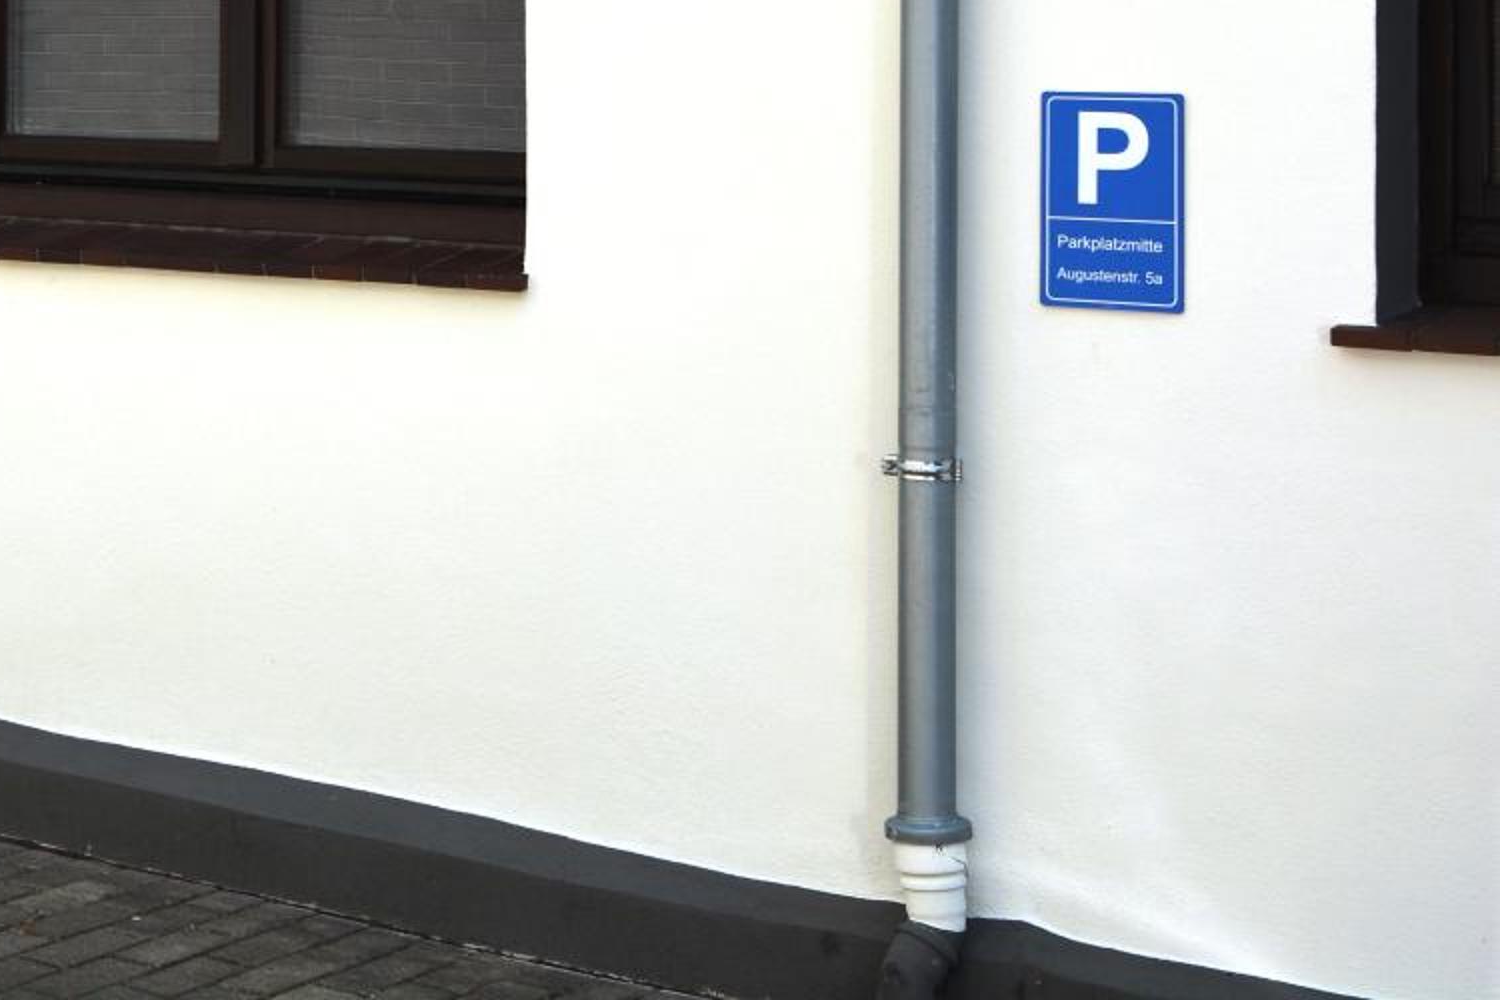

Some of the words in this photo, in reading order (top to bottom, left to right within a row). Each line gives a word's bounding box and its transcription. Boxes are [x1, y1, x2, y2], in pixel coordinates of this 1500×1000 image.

[1077, 110, 1150, 205] P
[1056, 266, 1141, 284] Augustenstr.
[1145, 271, 1164, 286] 5a
